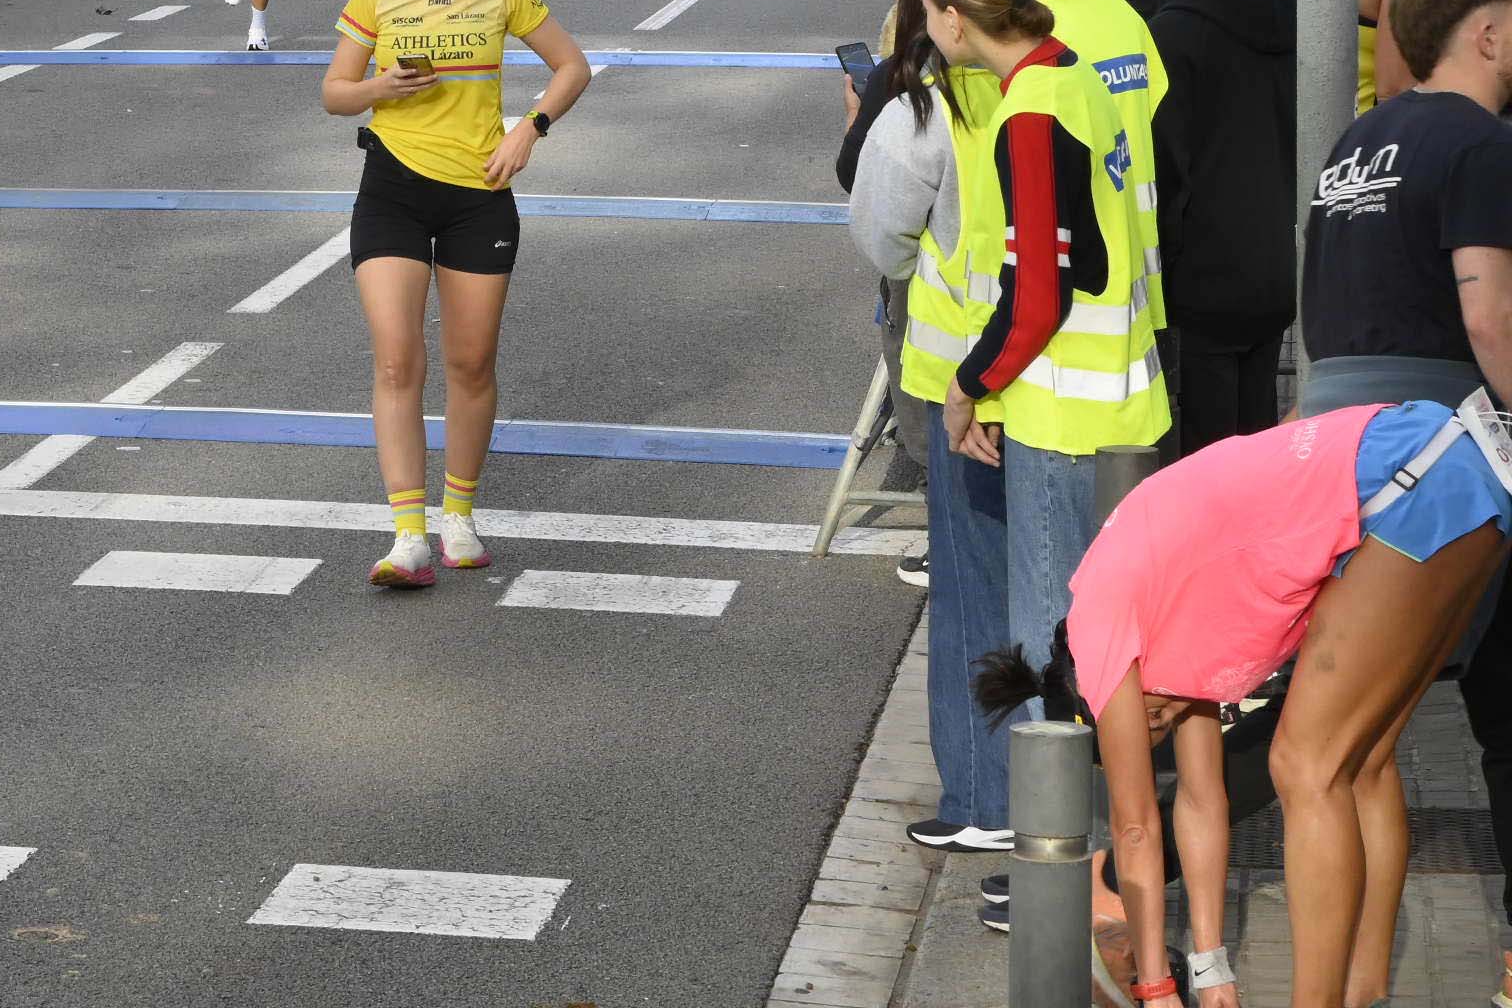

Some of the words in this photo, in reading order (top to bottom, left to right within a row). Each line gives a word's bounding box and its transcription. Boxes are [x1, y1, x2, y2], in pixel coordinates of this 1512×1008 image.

[391, 32, 487, 50] ATHLETICS
[431, 48, 474, 61] Lázaro
[1100, 63, 1148, 85] OLUNTA
